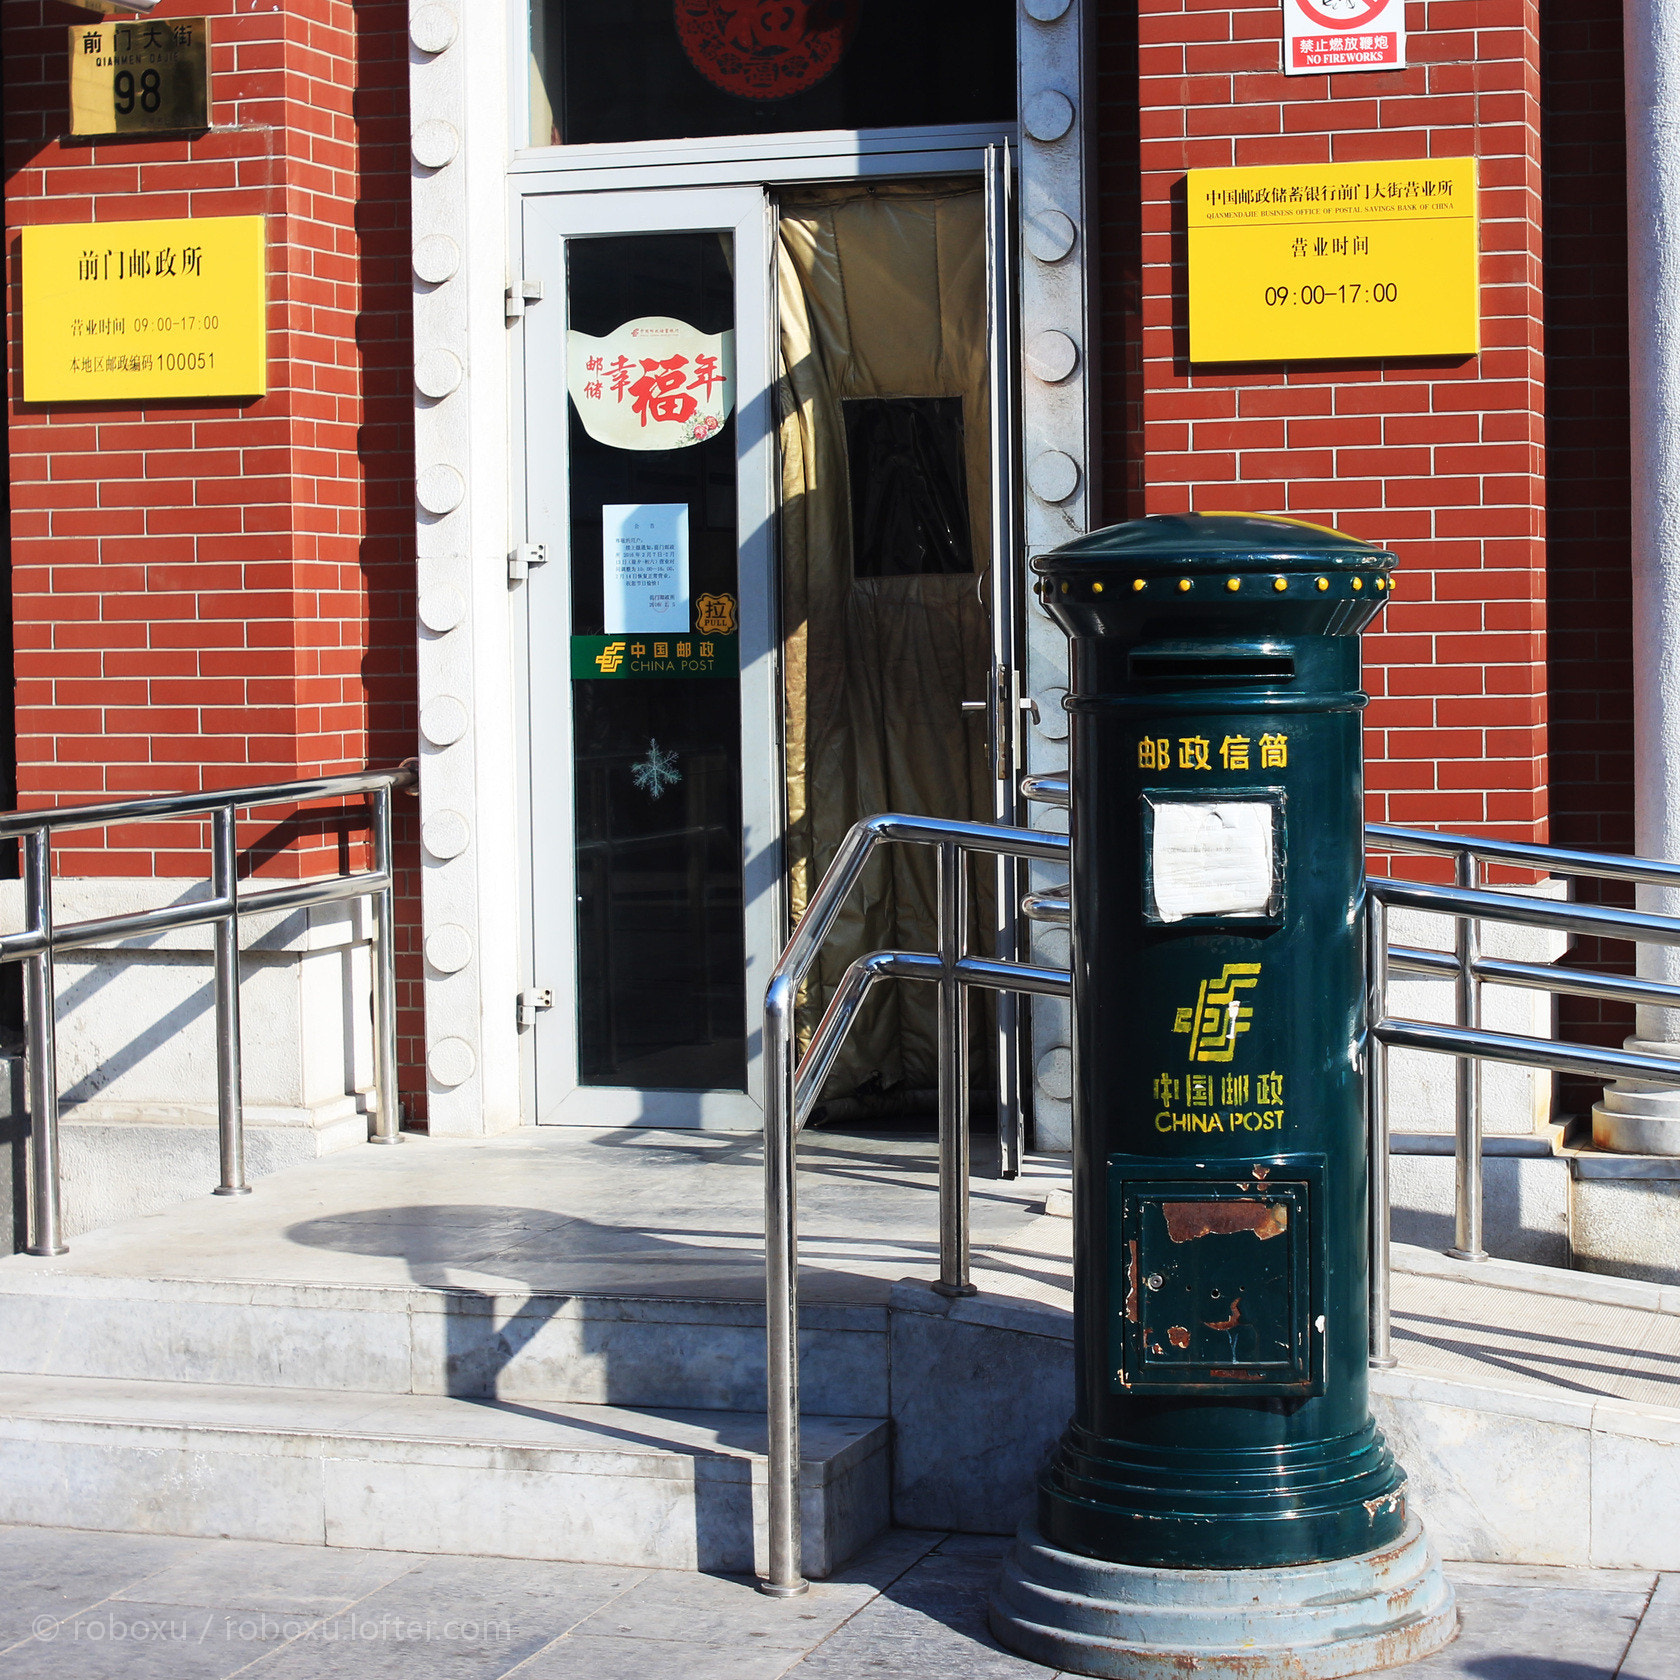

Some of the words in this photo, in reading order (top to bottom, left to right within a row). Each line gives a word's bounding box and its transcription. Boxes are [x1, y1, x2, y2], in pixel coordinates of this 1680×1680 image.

[83, 25, 192, 54] 前门大街
[1300, 35, 1388, 53] 禁止燃放鞭炮
[95, 55, 142, 67] QIANMEN
[1307, 55, 1321, 64] NO
[1324, 51, 1383, 63] FIREWORKS
[114, 68, 161, 114] 98
[1206, 180, 1453, 206] 中国邮政储蓄银行前门大街营业所
[1261, 209, 1293, 217] BUSINESS
[1295, 208, 1320, 216] OFFICE
[1323, 207, 1332, 215] OF
[1335, 206, 1362, 214] POSTAL
[1364, 205, 1395, 213] SAVINGS
[1397, 204, 1417, 212] BANK
[1431, 202, 1454, 210] CHINA
[1291, 235, 1369, 257] 营业时间
[78, 246, 203, 281] 前门邮政所
[1264, 282, 1398, 306] 09:00-17:00
[70, 317, 126, 337] 营业时间
[133, 315, 219, 333] 09:00-17:00
[601, 353, 727, 427] 幸福年
[705, 601, 727, 619] 拉
[704, 619, 727, 627] PULL
[630, 641, 714, 659] 中国邮政
[630, 660, 675, 672] CHINA
[681, 660, 715, 671] POST
[1138, 733, 1288, 771] 邮政信筒
[1153, 1071, 1284, 1108] 中国邮政
[1155, 1111, 1224, 1133] CHINA
[1230, 1109, 1285, 1132] POST
